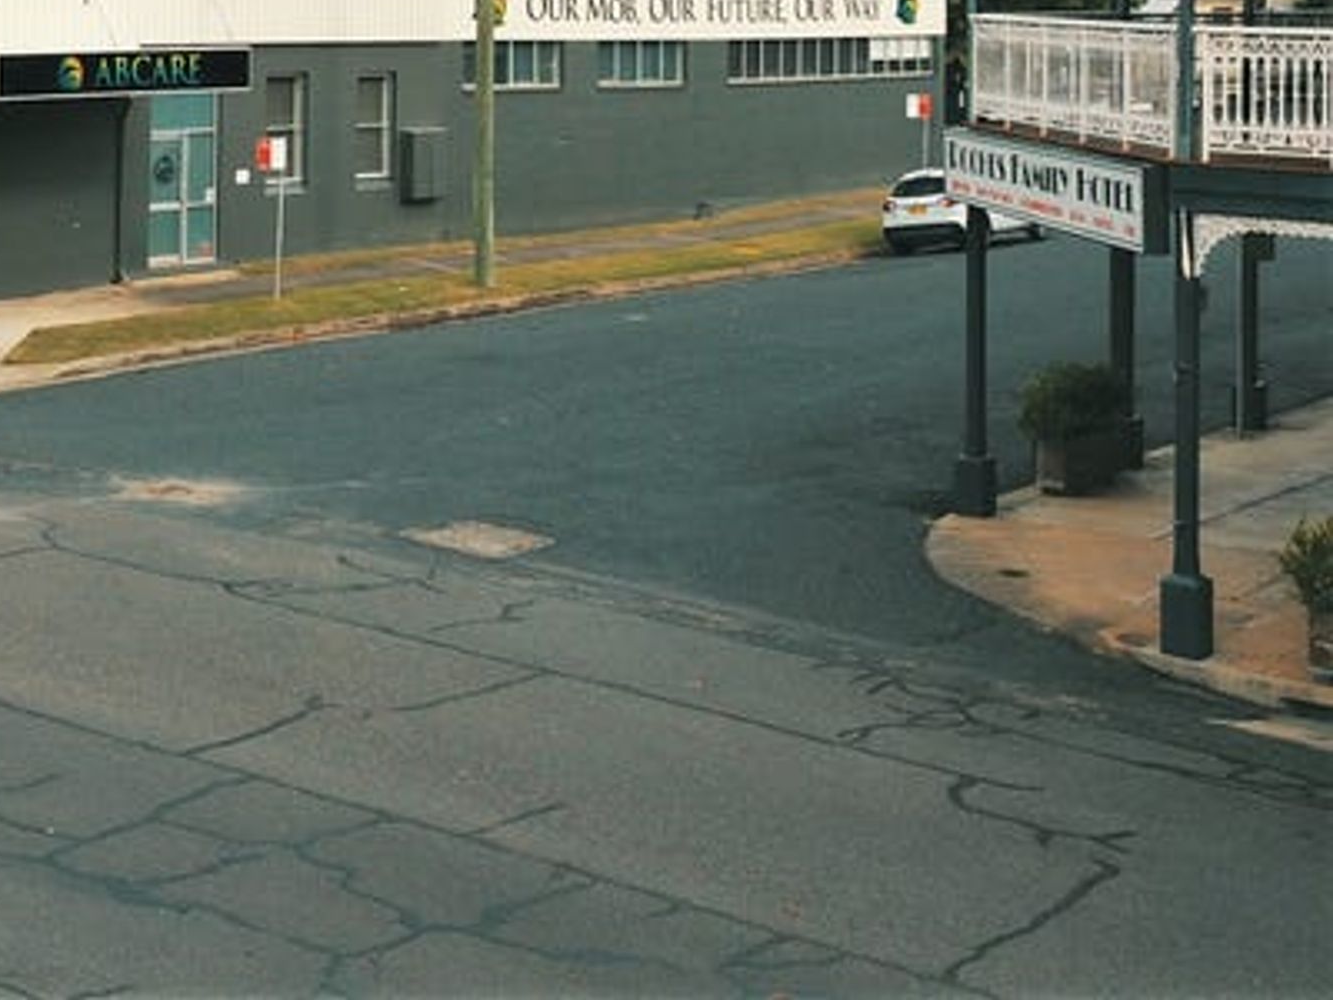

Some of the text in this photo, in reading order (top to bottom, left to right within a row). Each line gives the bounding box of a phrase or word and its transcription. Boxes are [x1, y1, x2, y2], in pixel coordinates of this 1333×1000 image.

[95, 52, 203, 88] ABCARE
[1010, 153, 1068, 195] FAMILY
[1075, 166, 1133, 213] HOTEL
